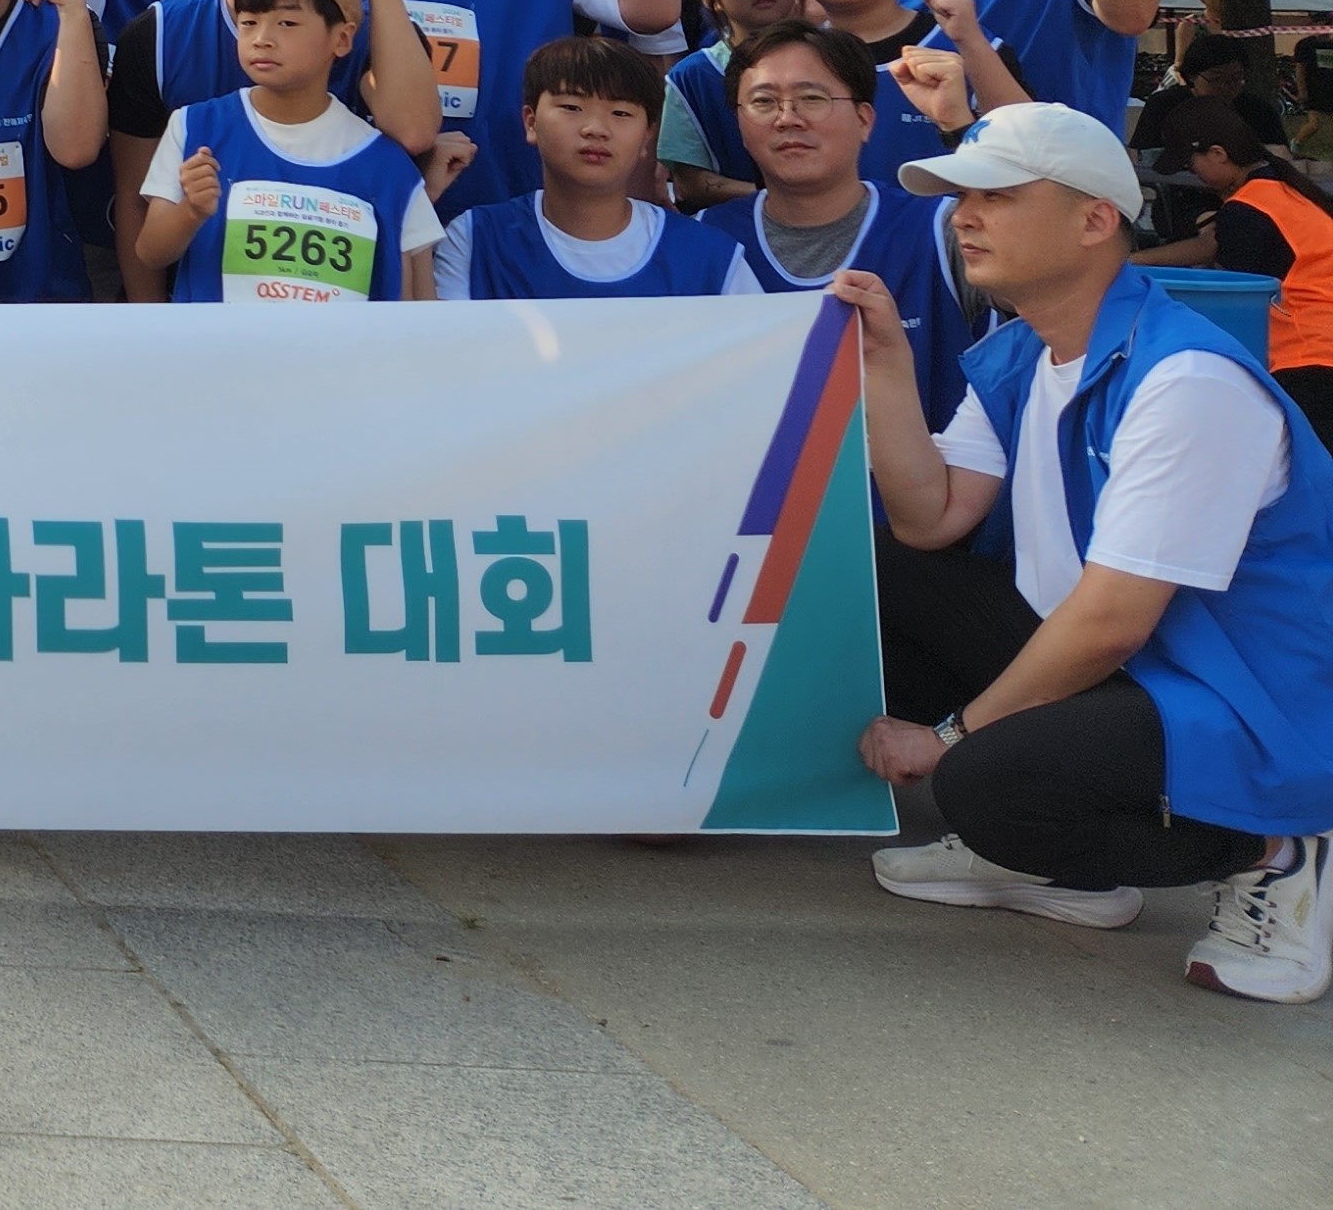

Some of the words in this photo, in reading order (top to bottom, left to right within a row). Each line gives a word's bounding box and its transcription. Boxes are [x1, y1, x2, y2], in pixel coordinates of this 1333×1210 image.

[245, 224, 352, 272] 5263
[257, 281, 330, 303] OSSTEM
[340, 515, 593, 663] 대회
